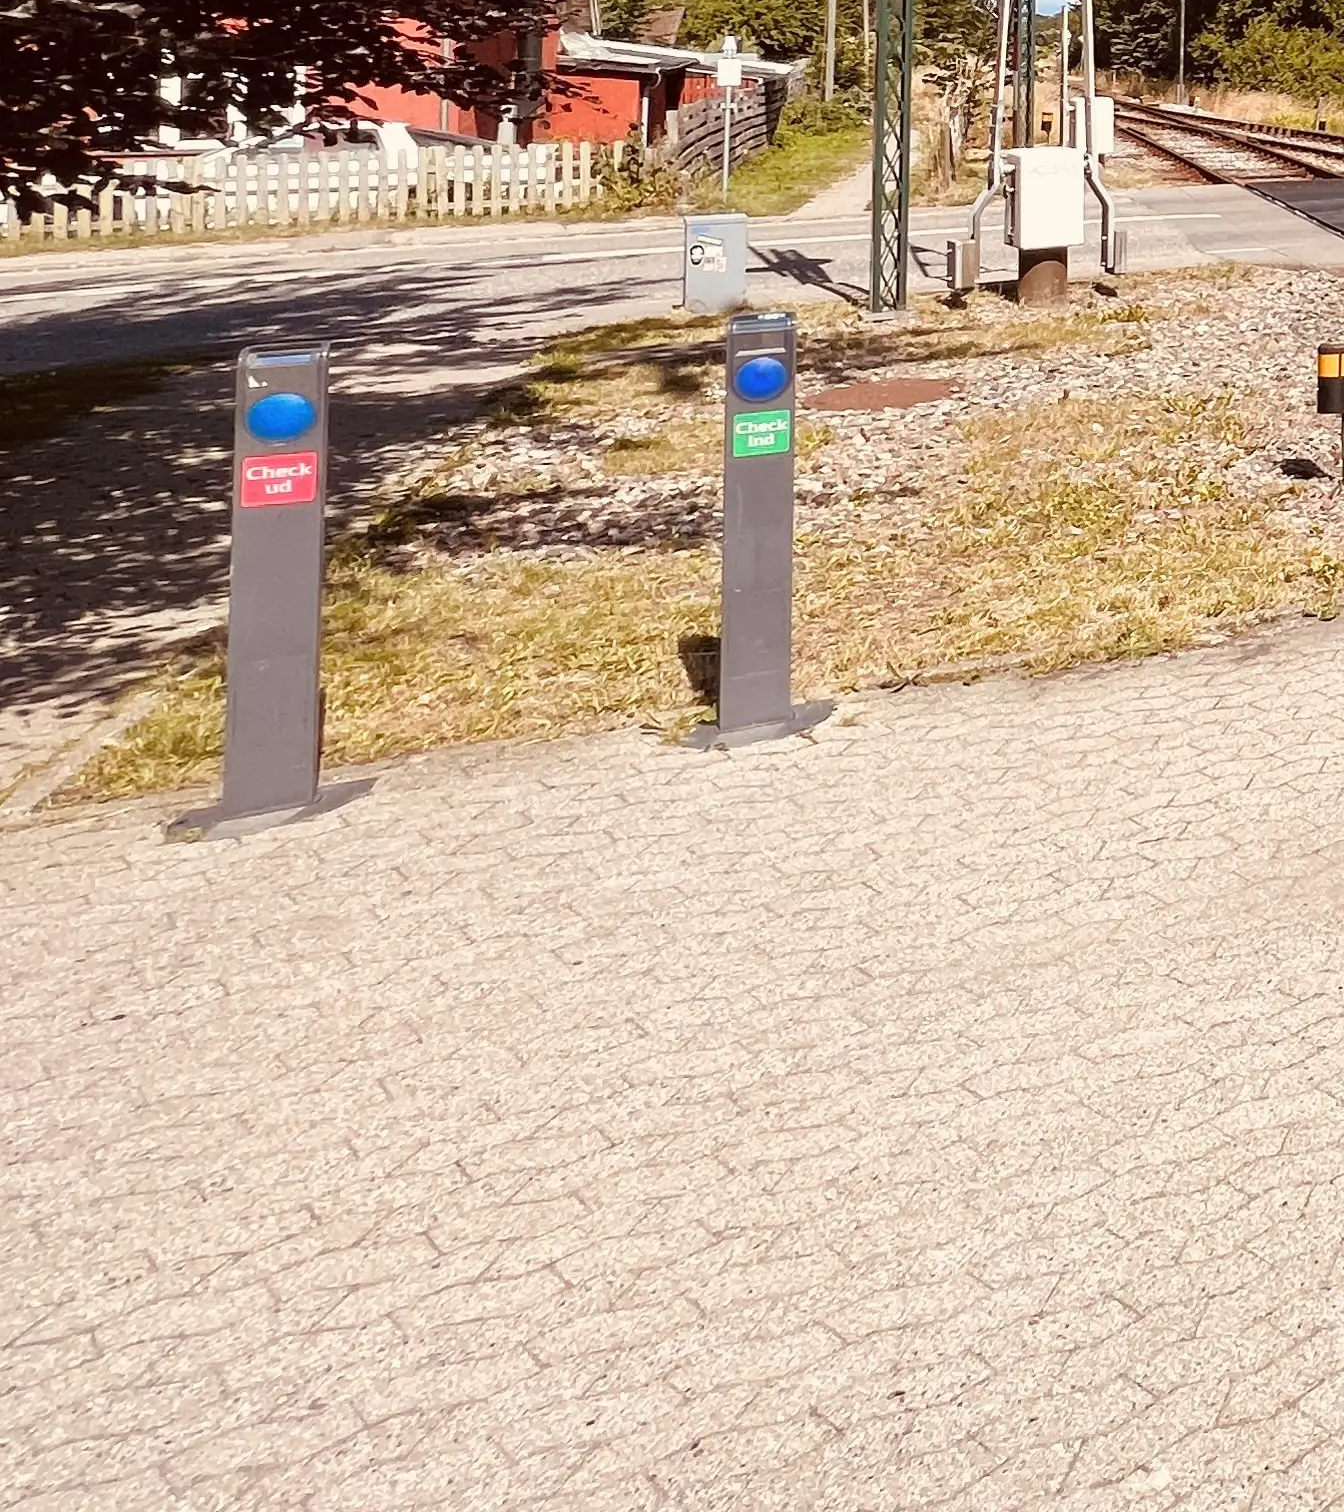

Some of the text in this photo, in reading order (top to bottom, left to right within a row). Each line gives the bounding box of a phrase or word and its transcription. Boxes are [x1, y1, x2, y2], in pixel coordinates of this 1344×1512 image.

[735, 418, 788, 434] Check
[246, 462, 313, 481] Check
[264, 479, 293, 495] ud
